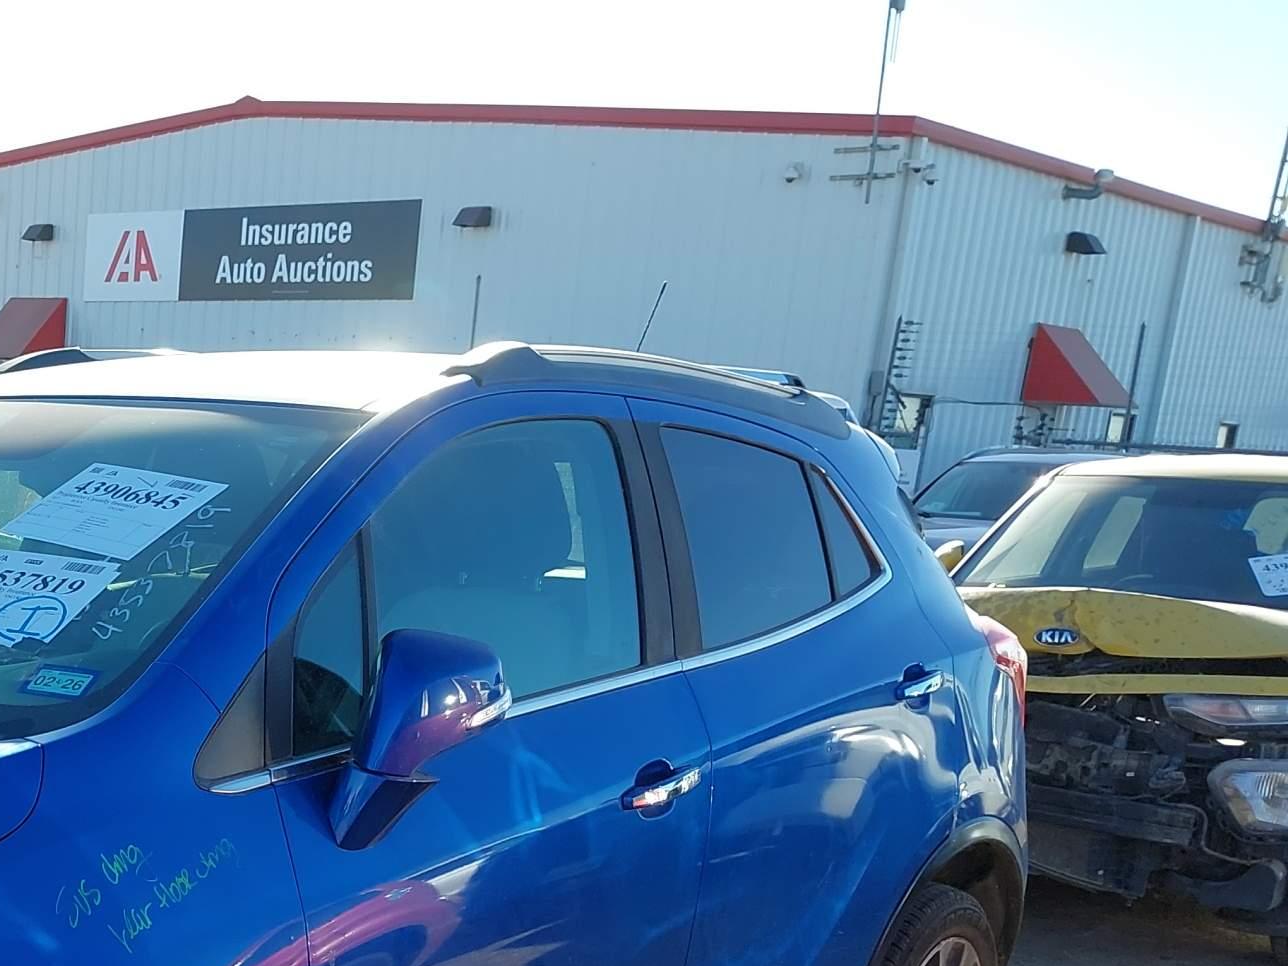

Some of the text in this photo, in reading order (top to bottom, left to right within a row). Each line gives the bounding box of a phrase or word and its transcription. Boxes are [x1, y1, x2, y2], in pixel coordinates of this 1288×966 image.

[240, 217, 352, 246] Insurance
[215, 253, 373, 284] Auto Auctions
[74, 479, 188, 510] 43906845
[1041, 631, 1073, 643] KIA
